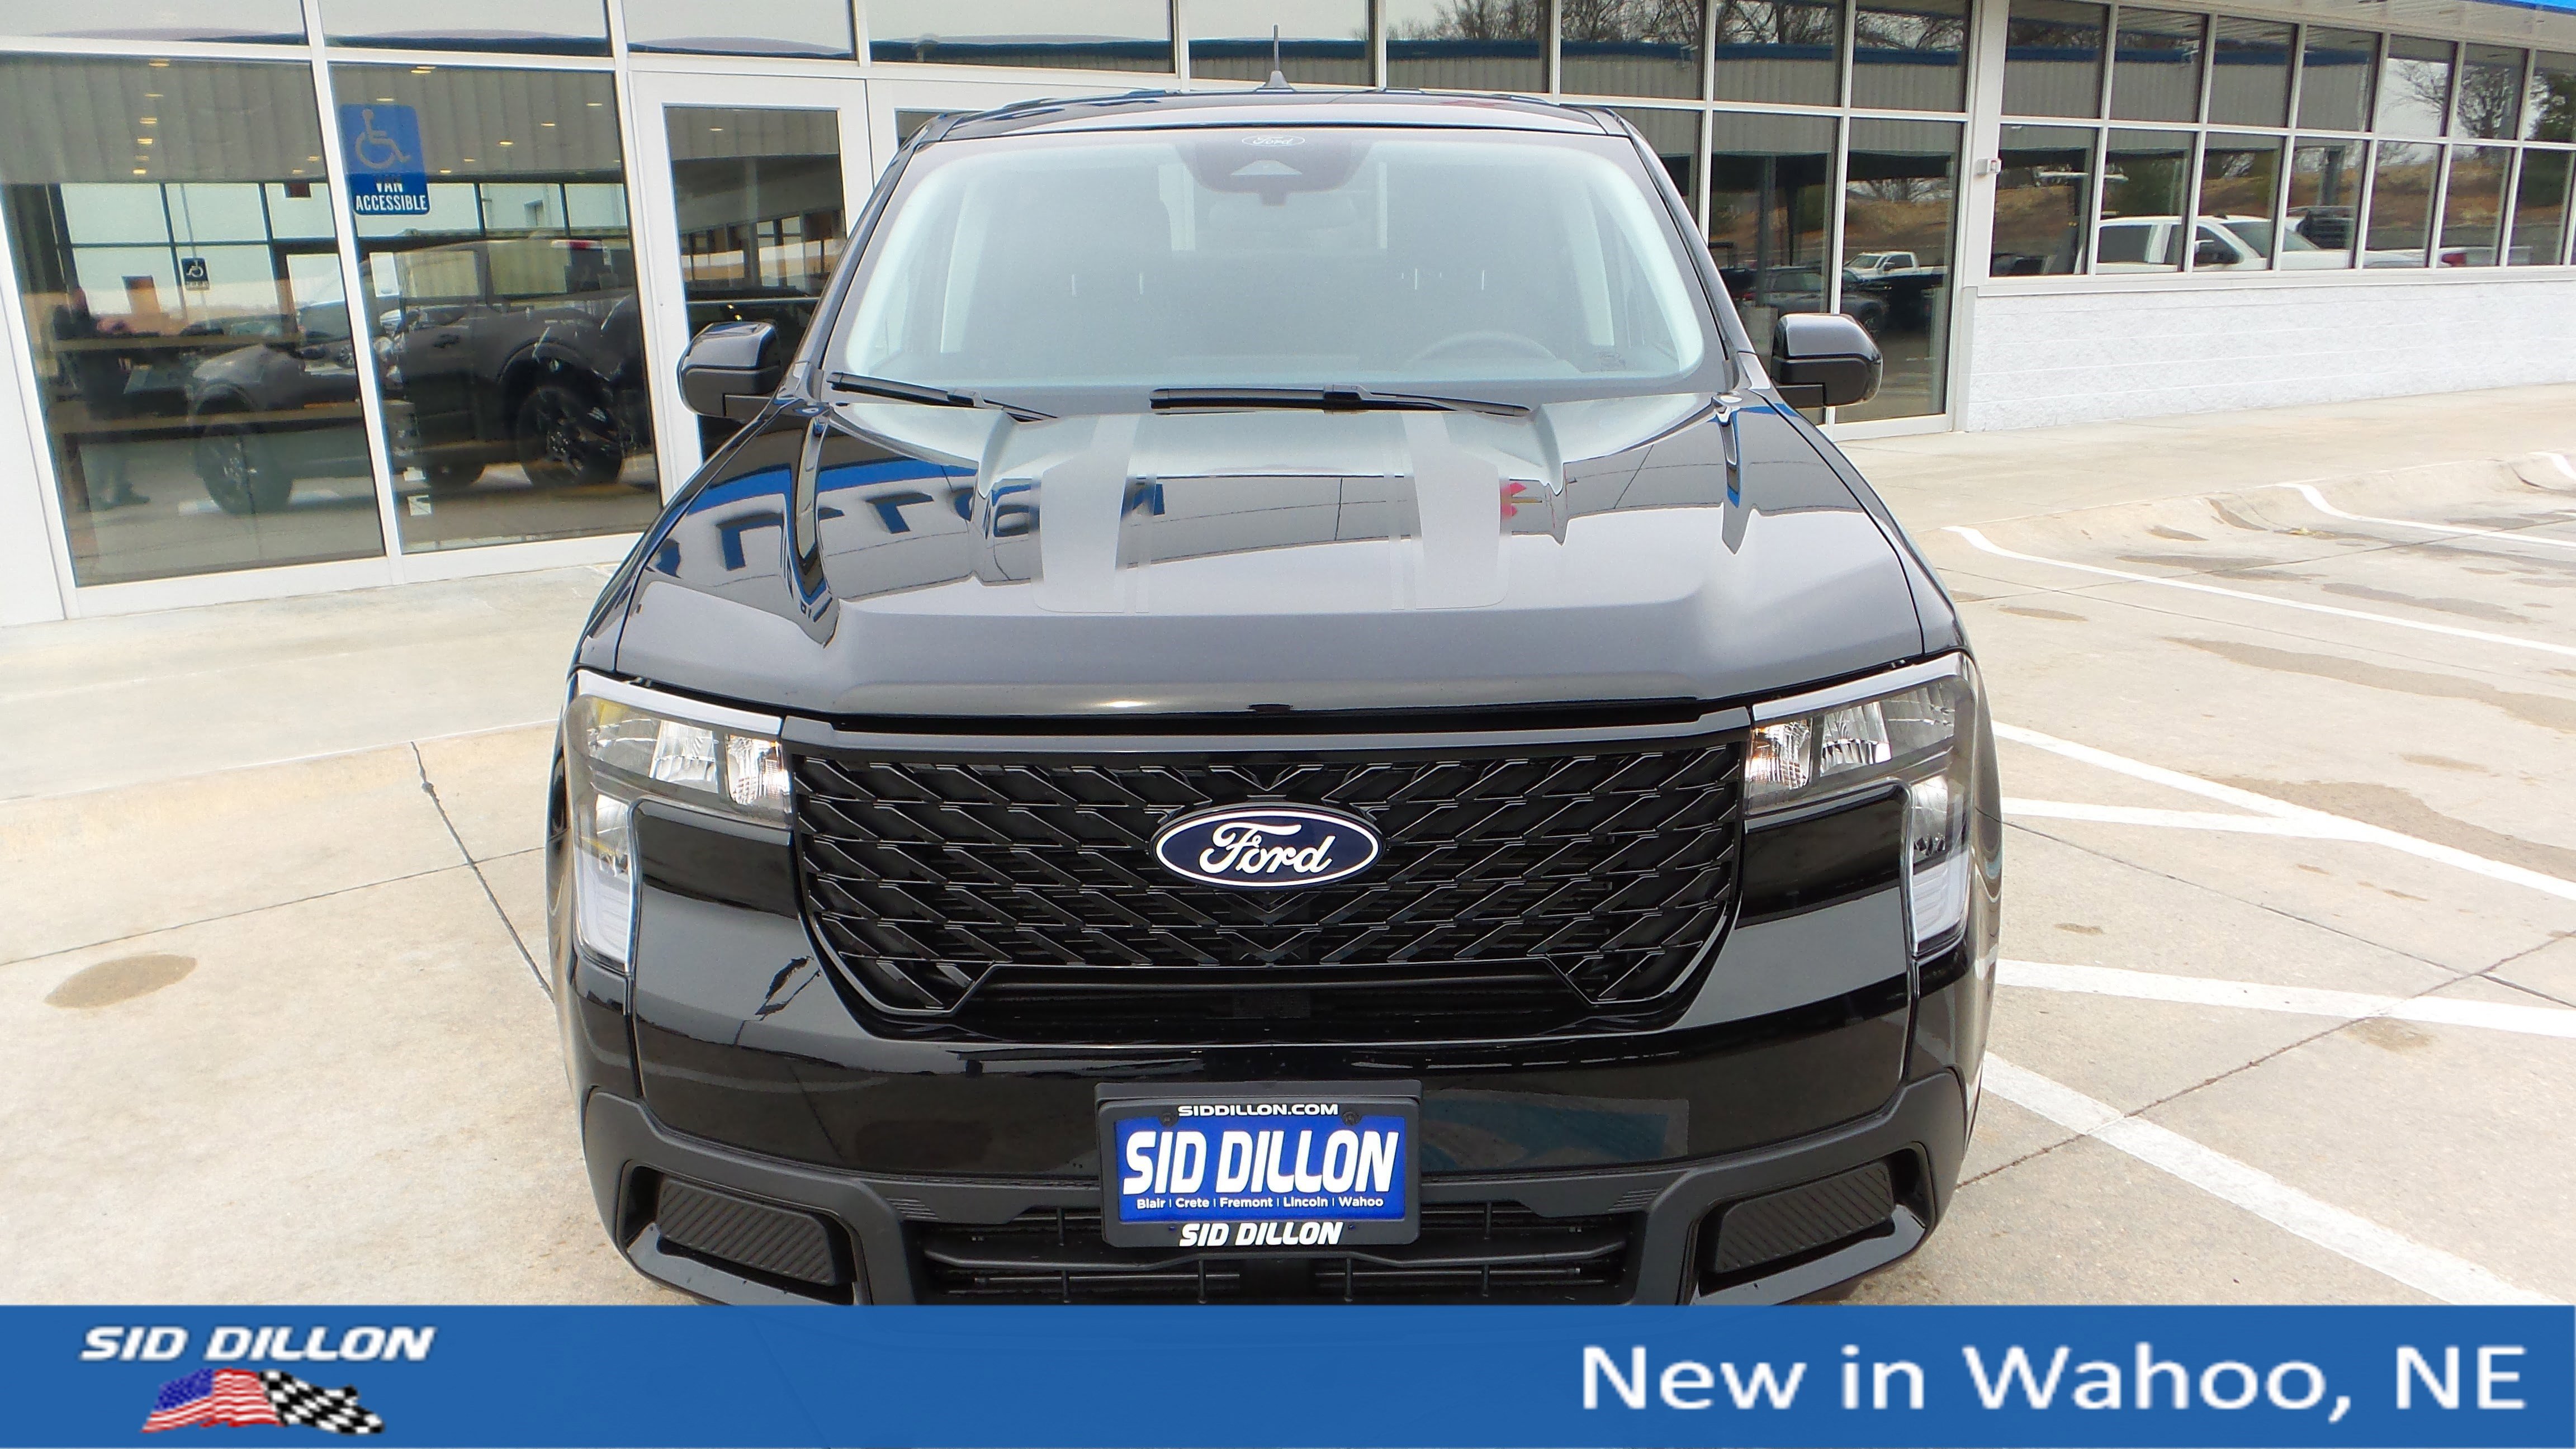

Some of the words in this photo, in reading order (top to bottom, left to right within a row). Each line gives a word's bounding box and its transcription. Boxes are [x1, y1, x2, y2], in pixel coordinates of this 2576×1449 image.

[1253, 136, 1294, 145] Ford
[356, 195, 428, 211] ACCESSIBLE
[1199, 822, 1336, 874] Ford
[1178, 1104, 1339, 1117] SIDDILLON.COM
[1123, 1130, 1207, 1195] SID
[1215, 1129, 1399, 1194] DILLON
[1137, 1197, 1166, 1209] Blair
[1175, 1197, 1210, 1208] Crete
[1220, 1197, 1273, 1208] Fremont
[1283, 1196, 1328, 1207] Lincoln
[1338, 1196, 1384, 1207] Wahoo
[1178, 1223, 1229, 1247] SID
[1234, 1221, 1343, 1246] DILLON
